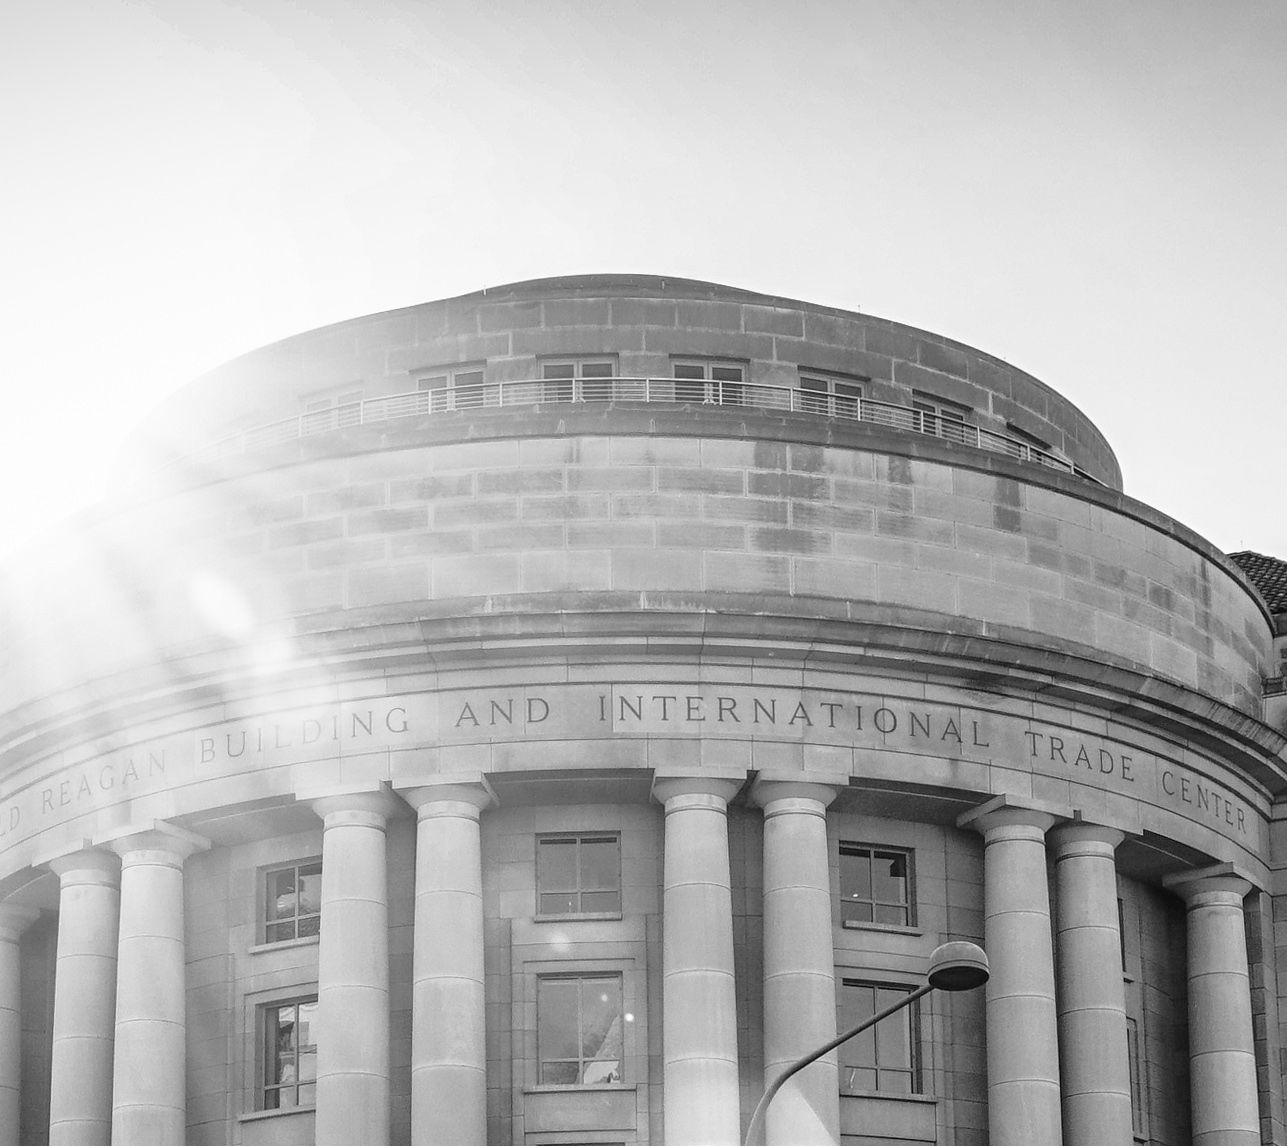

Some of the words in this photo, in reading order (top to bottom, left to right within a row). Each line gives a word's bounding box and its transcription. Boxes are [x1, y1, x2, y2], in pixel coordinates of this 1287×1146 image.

[41, 752, 166, 815] REAGAN
[200, 707, 410, 763] BUILDING
[454, 697, 550, 728] AND
[598, 694, 991, 750] INTERNATIONAL
[1024, 730, 1136, 783] TRADE
[1162, 770, 1250, 836] CENTER
